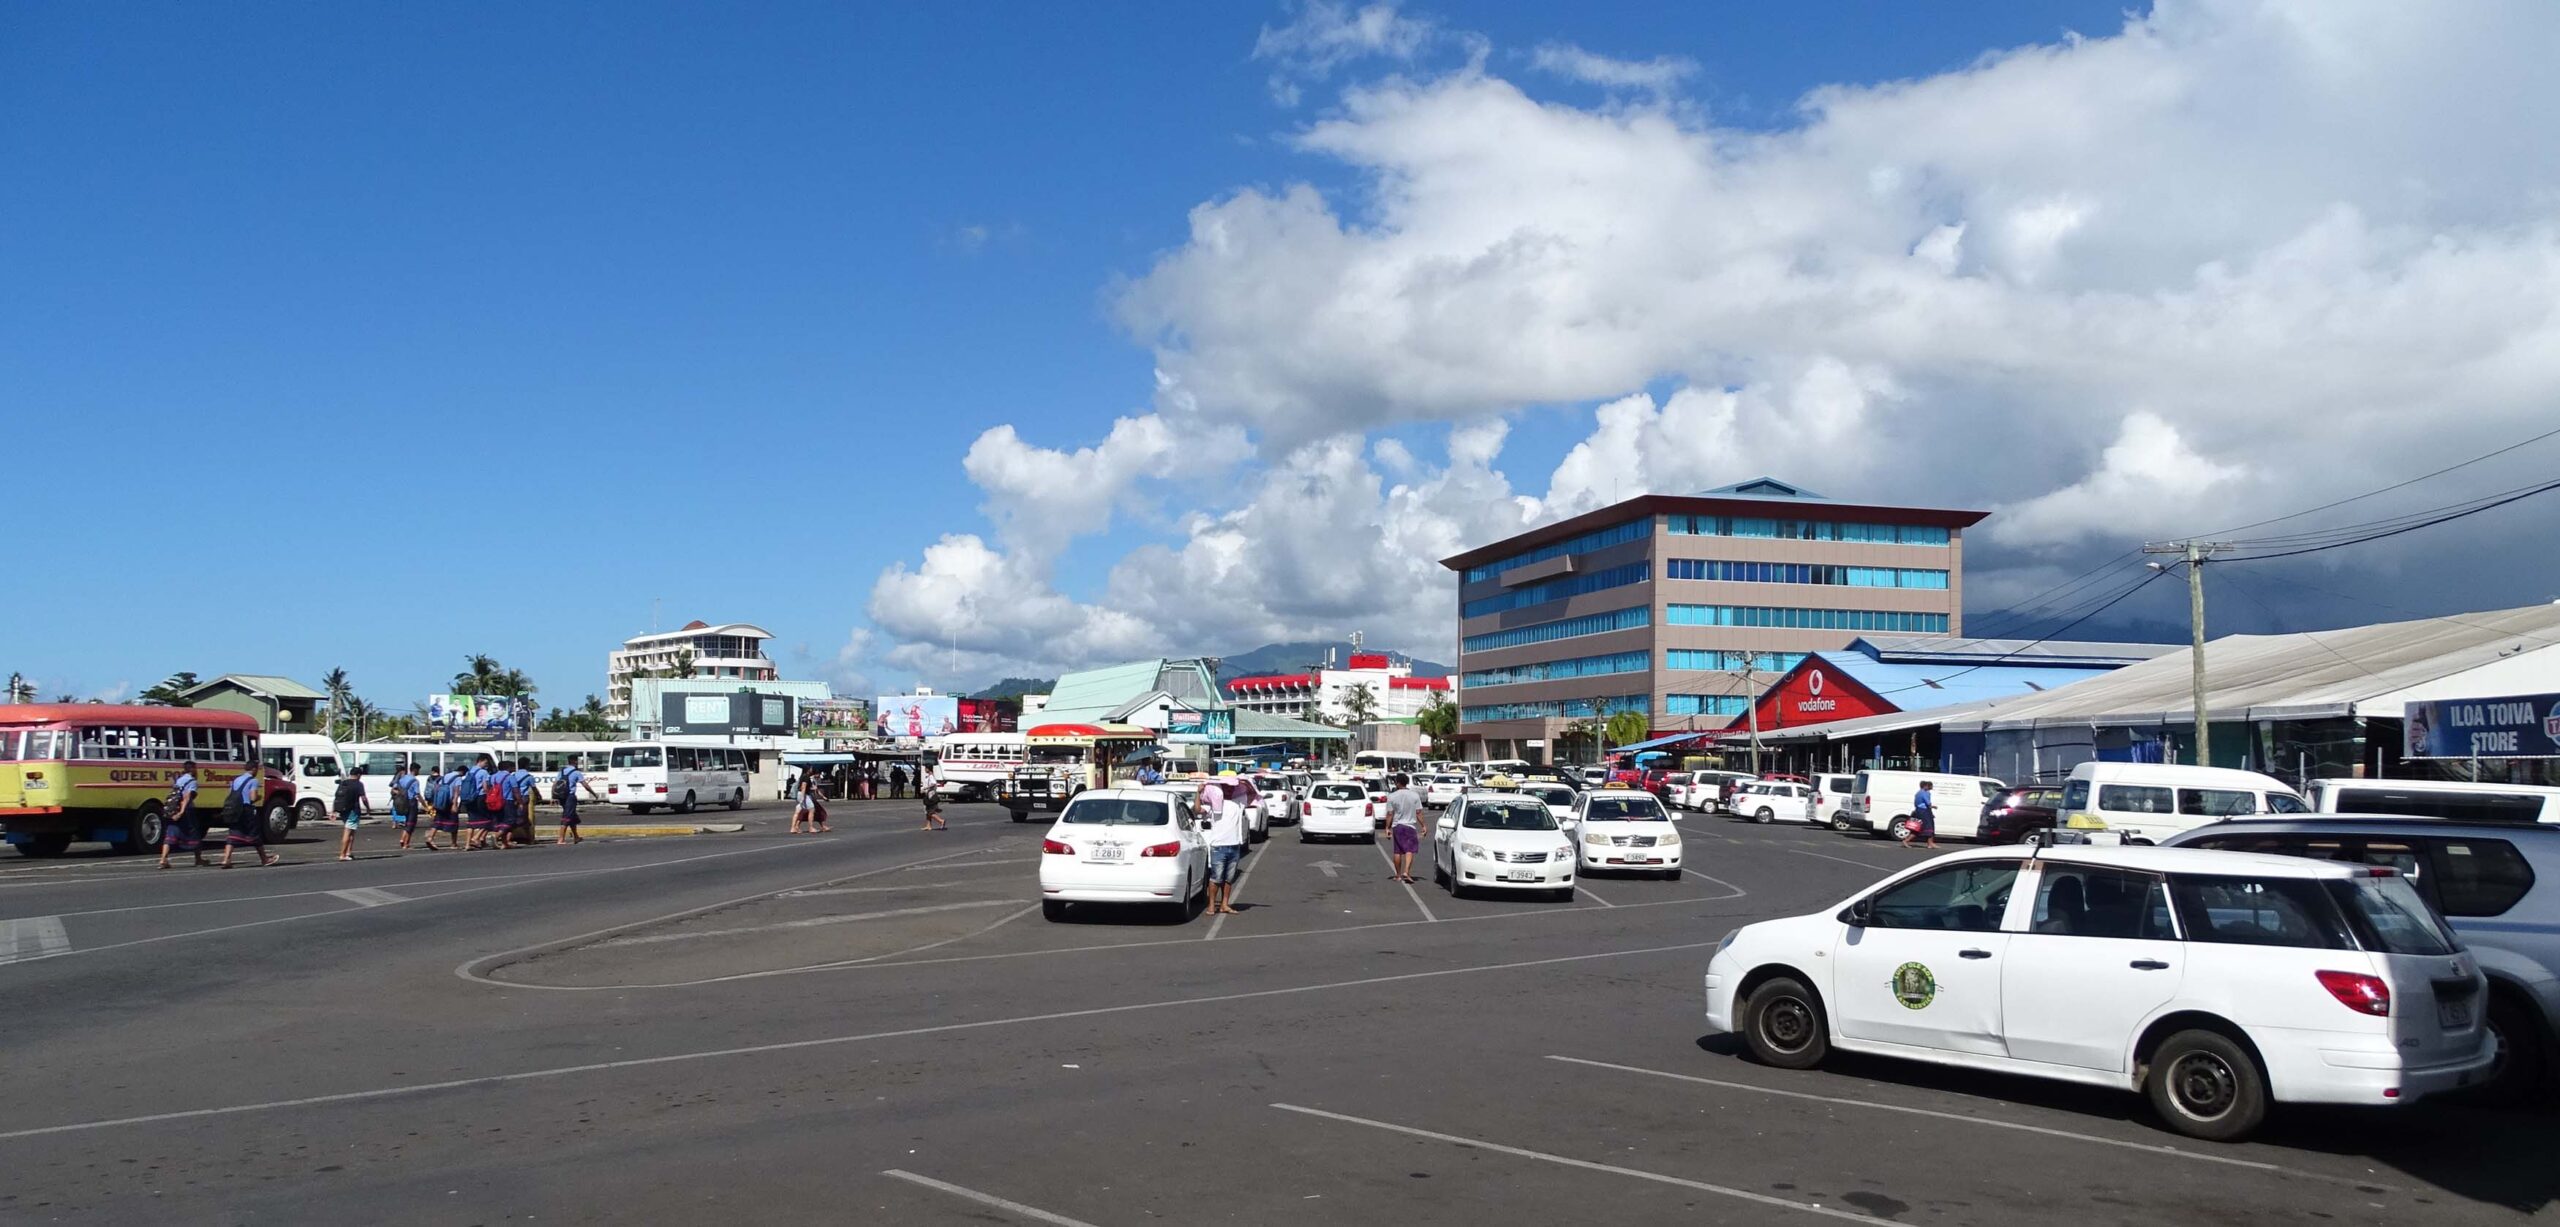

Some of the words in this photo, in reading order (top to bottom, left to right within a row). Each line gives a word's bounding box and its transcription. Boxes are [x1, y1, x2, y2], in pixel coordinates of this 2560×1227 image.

[1797, 698, 1836, 712] vodafone
[2450, 704, 2485, 727] ILOA
[2487, 702, 2536, 726] TOIVA
[2470, 731, 2518, 752] STORE
[110, 770, 158, 782] QUEEN
